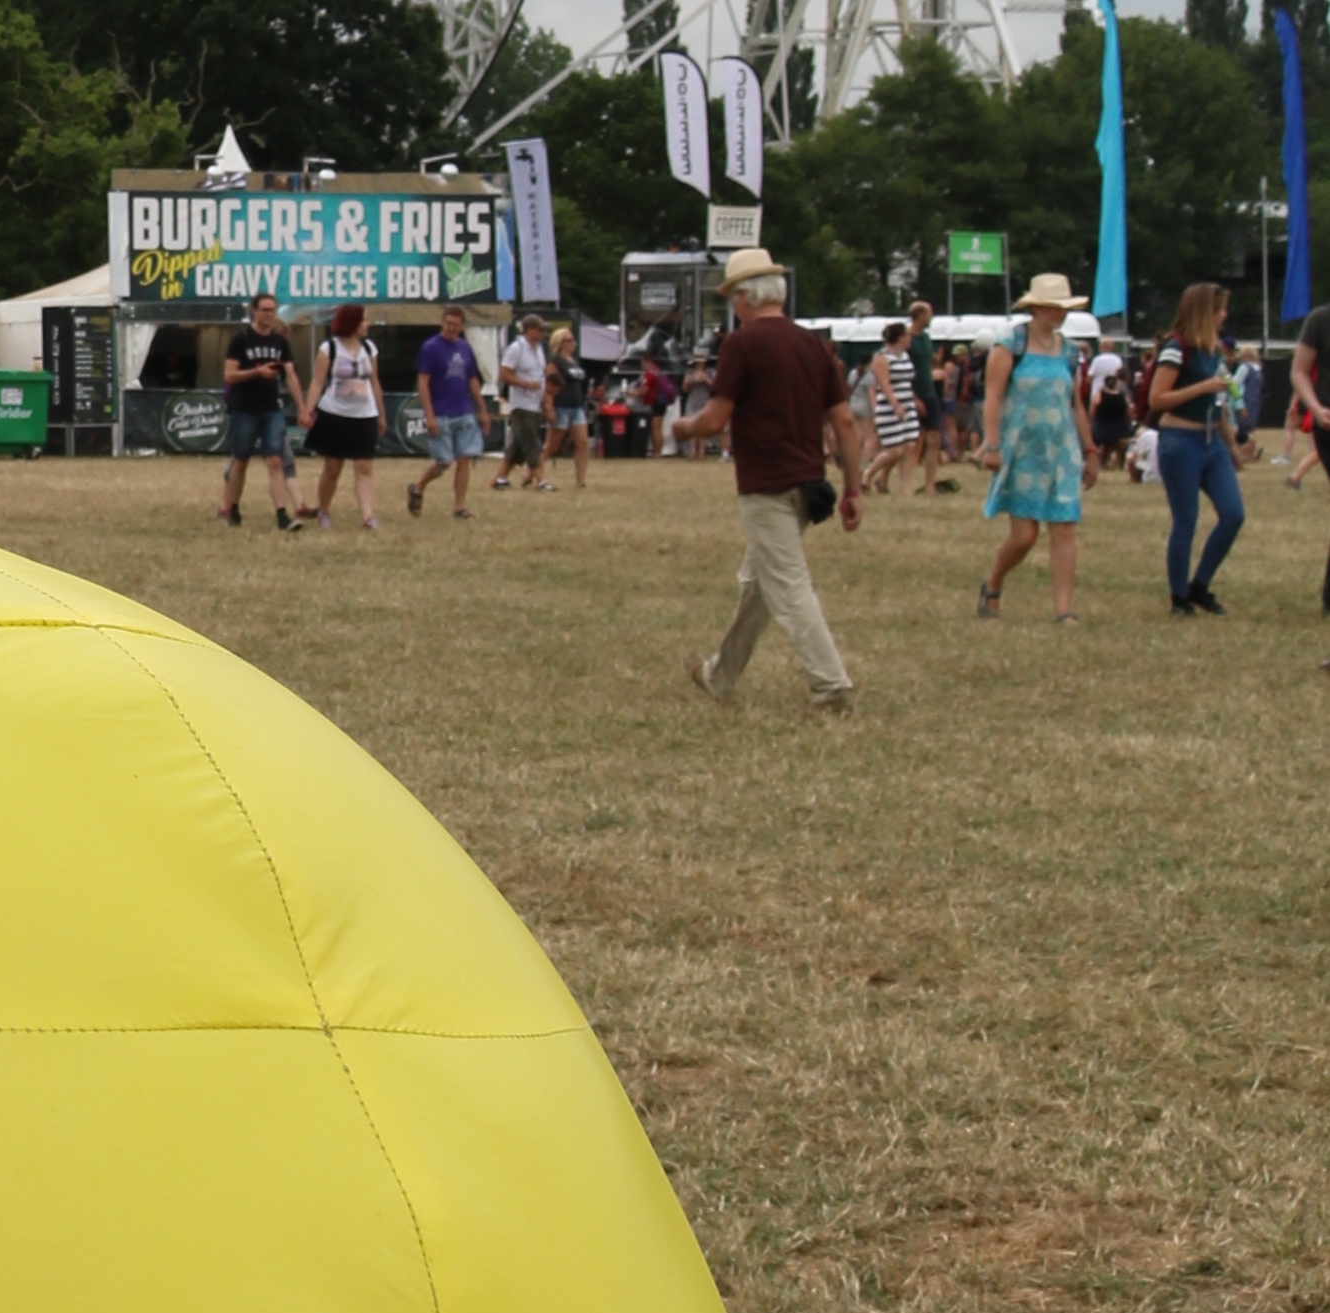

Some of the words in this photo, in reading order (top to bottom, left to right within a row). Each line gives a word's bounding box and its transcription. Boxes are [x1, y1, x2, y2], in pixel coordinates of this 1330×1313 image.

[132, 197, 324, 253] BURGERS
[335, 199, 369, 254] &
[379, 201, 492, 255] FRIES
[131, 238, 224, 286] Dipped
[195, 263, 281, 297] GRAVY
[289, 264, 378, 298] CHEESE
[387, 266, 439, 301] BBQ
[160, 278, 184, 301] in
